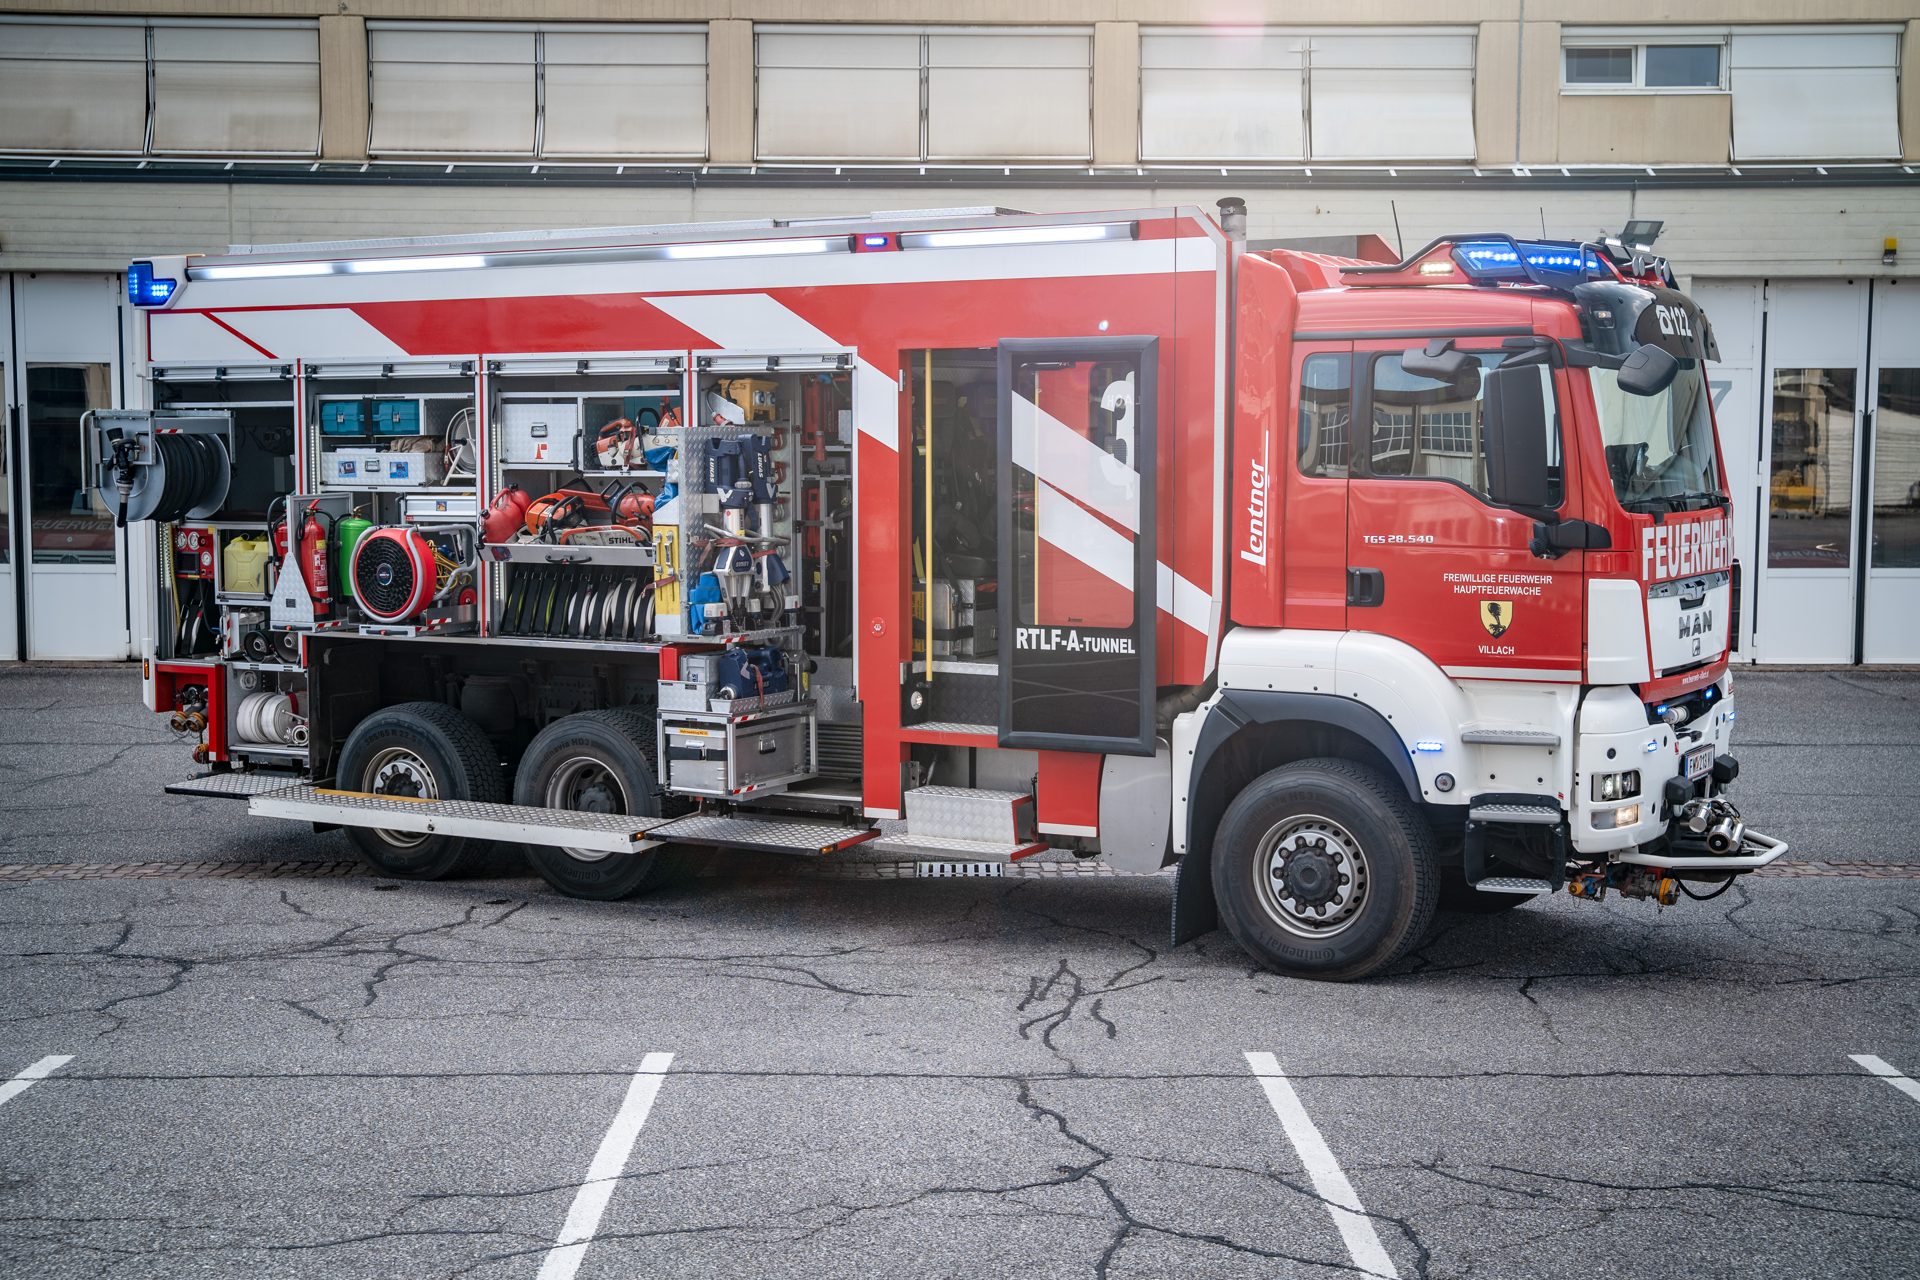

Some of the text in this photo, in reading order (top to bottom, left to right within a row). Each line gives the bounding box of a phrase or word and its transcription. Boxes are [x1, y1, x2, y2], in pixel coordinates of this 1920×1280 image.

[1669, 306, 1692, 337] 122
[608, 537, 634, 545] STIHL
[1363, 534, 1434, 544] TGS 28.540
[1443, 573, 1552, 584] FREIWILLIGE FEUERWEHR
[1454, 585, 1541, 596] HAUPTFEUERWACHE
[1678, 610, 1712, 639] MAN
[1478, 645, 1515, 655] VILLACH
[1265, 937, 1336, 961] Continental
